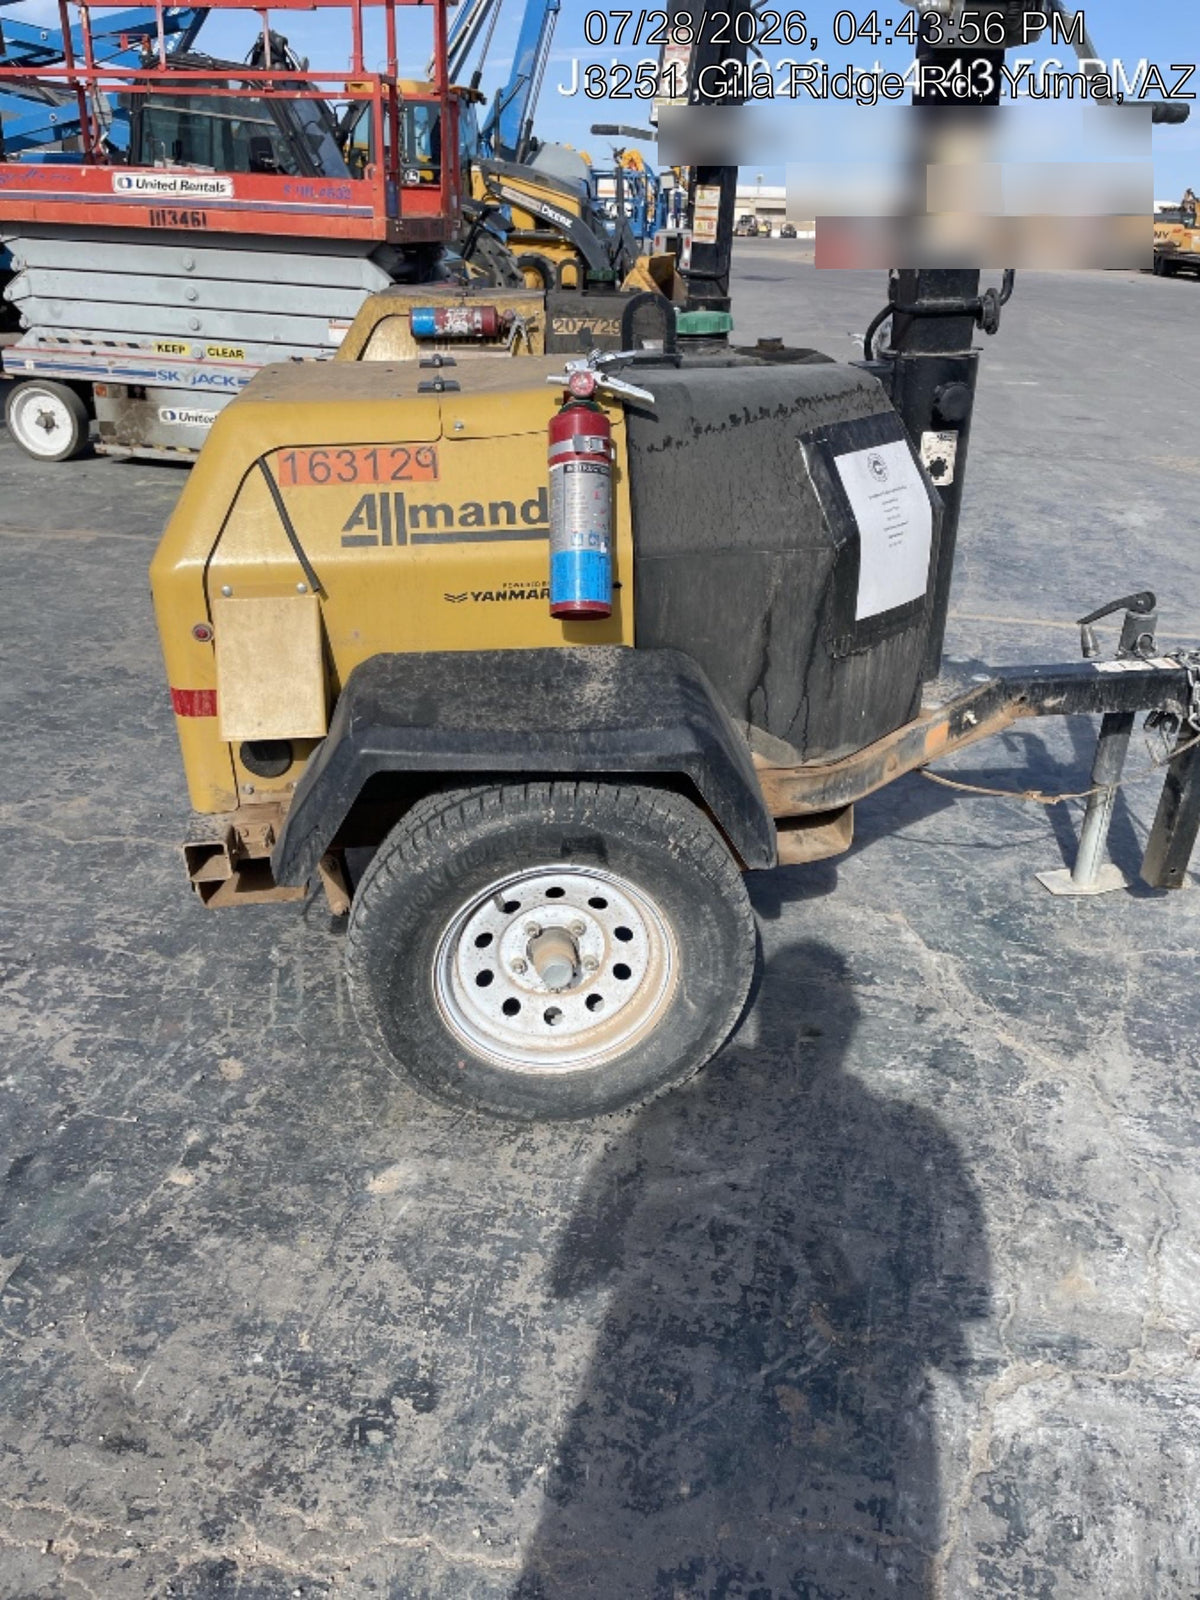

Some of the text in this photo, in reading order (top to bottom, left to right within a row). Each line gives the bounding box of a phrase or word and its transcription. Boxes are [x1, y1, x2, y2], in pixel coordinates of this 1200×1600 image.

[136, 178, 226, 193] United Rentals
[553, 318, 621, 335] 207729
[157, 344, 245, 359] KEEP CLEAR
[156, 369, 237, 387] SKYJACK
[280, 446, 440, 485] 163129
[341, 487, 549, 546] Allmand
